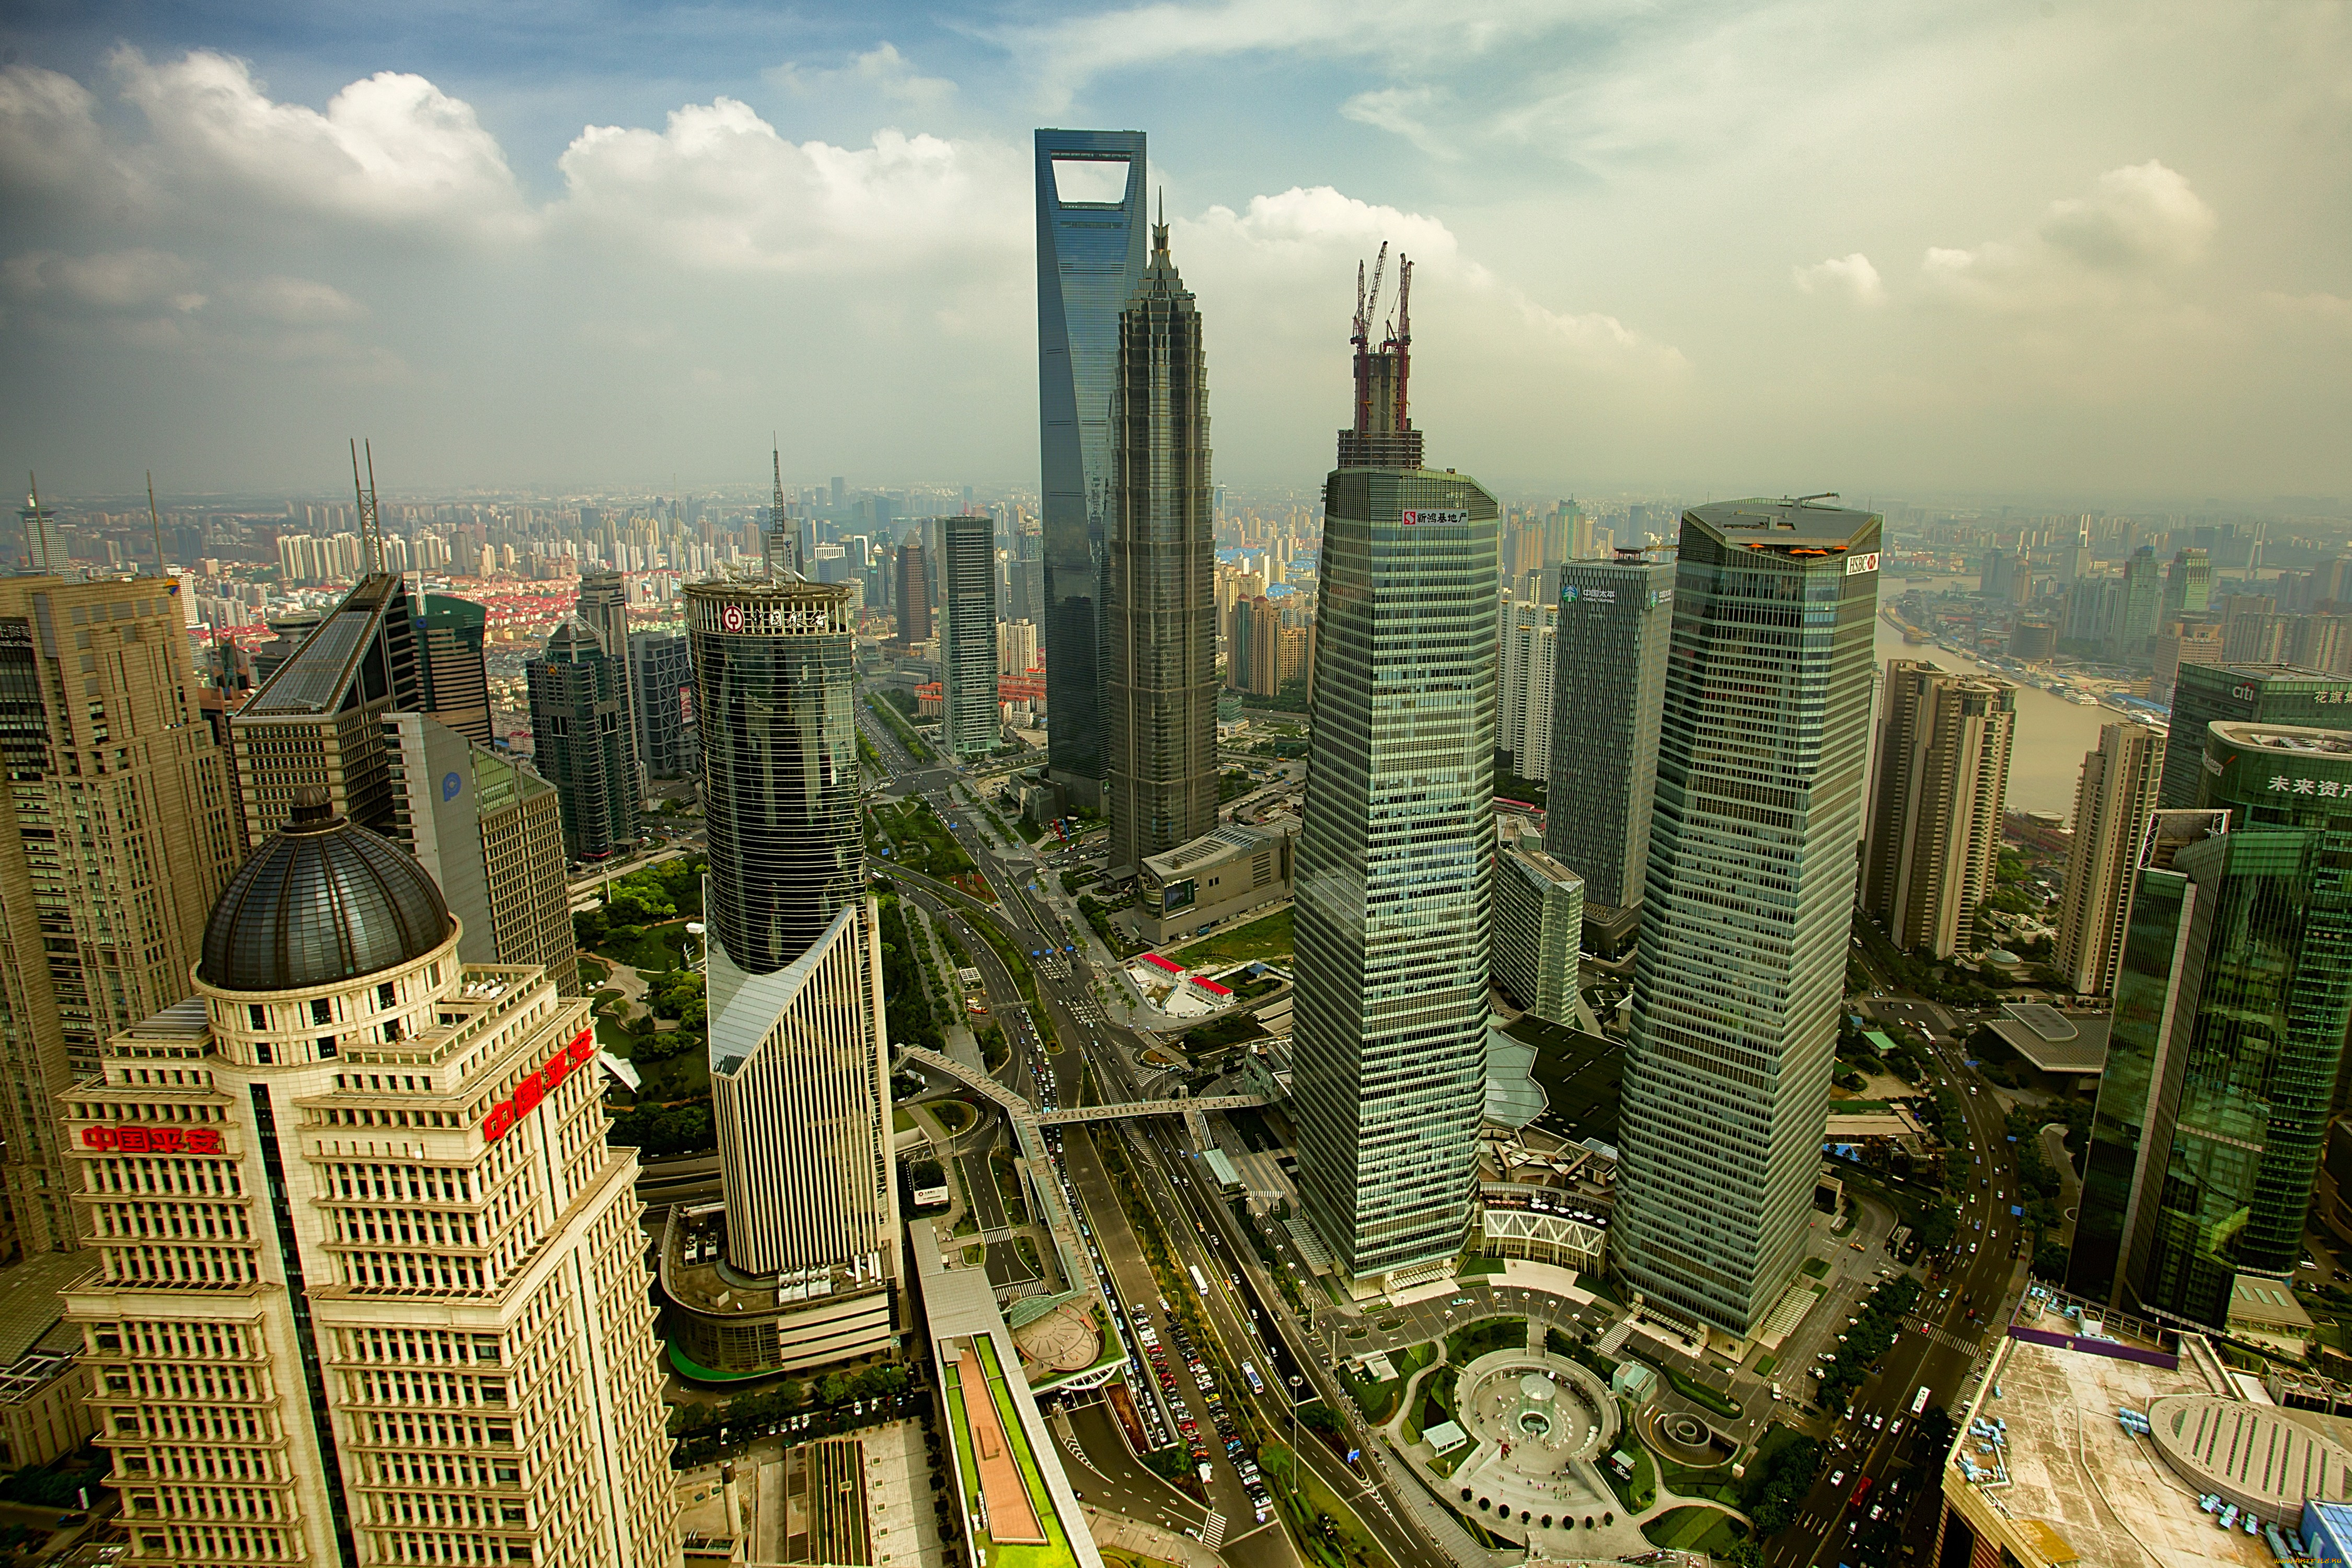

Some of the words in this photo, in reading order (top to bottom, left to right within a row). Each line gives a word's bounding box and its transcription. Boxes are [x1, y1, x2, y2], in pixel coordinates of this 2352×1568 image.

[1417, 512, 1467, 523] 新鸿基地产
[1849, 556, 1867, 573] HSBC
[1583, 589, 1615, 598] 中国太平
[2232, 685, 2254, 701] citi
[483, 1028, 594, 1142] 中国平安
[82, 1125, 221, 1155] 中国平安
